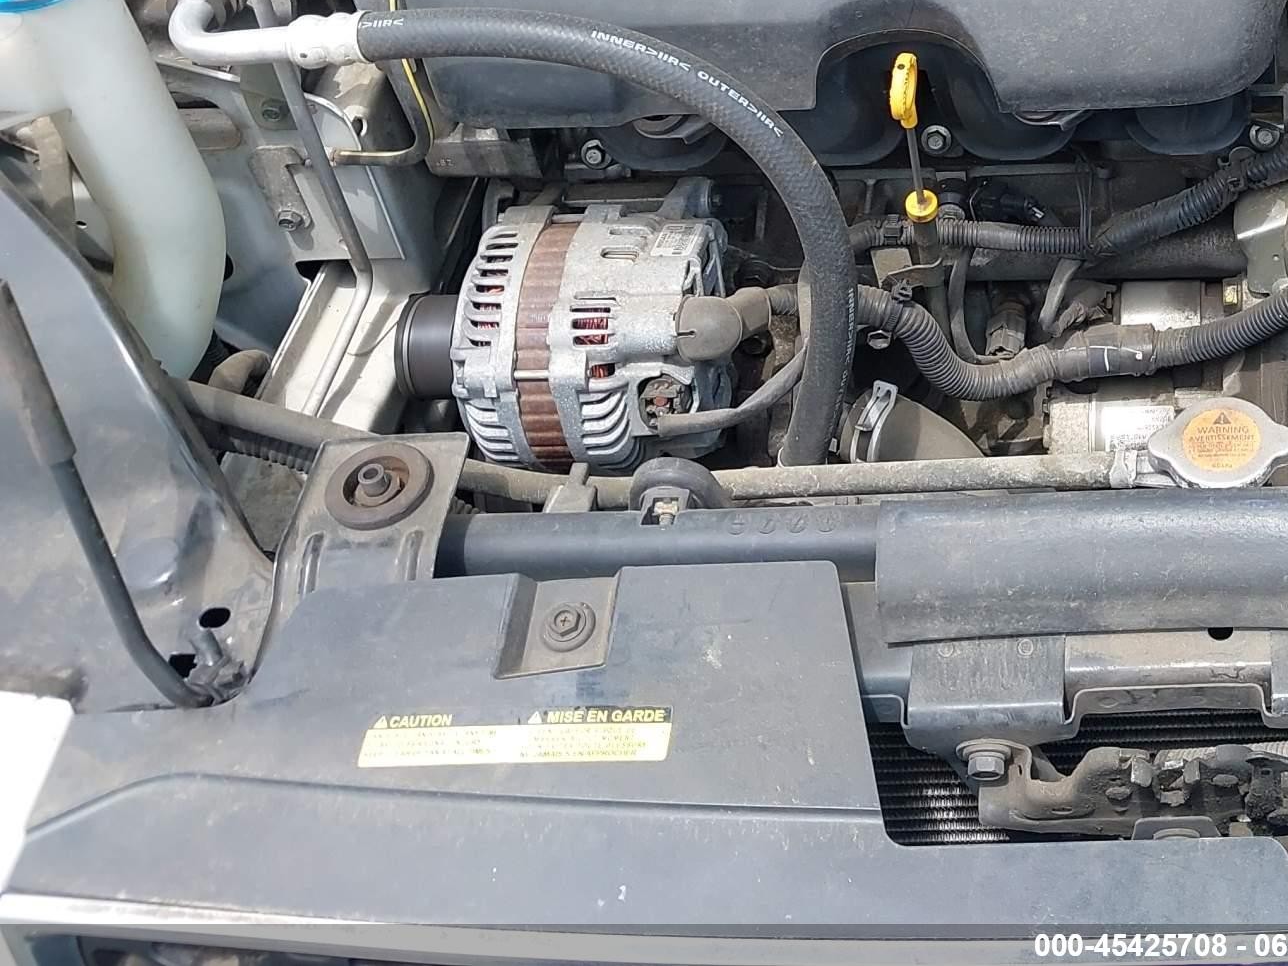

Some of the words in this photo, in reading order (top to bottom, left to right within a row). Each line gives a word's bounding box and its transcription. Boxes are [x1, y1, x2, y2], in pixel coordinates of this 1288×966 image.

[1197, 425, 1249, 434] WARNING
[1188, 434, 1255, 442] AVERTISSEMENT
[389, 713, 453, 728] CAUTION
[546, 710, 584, 723] MISE
[586, 710, 607, 723] EN
[611, 709, 666, 722] GARDE
